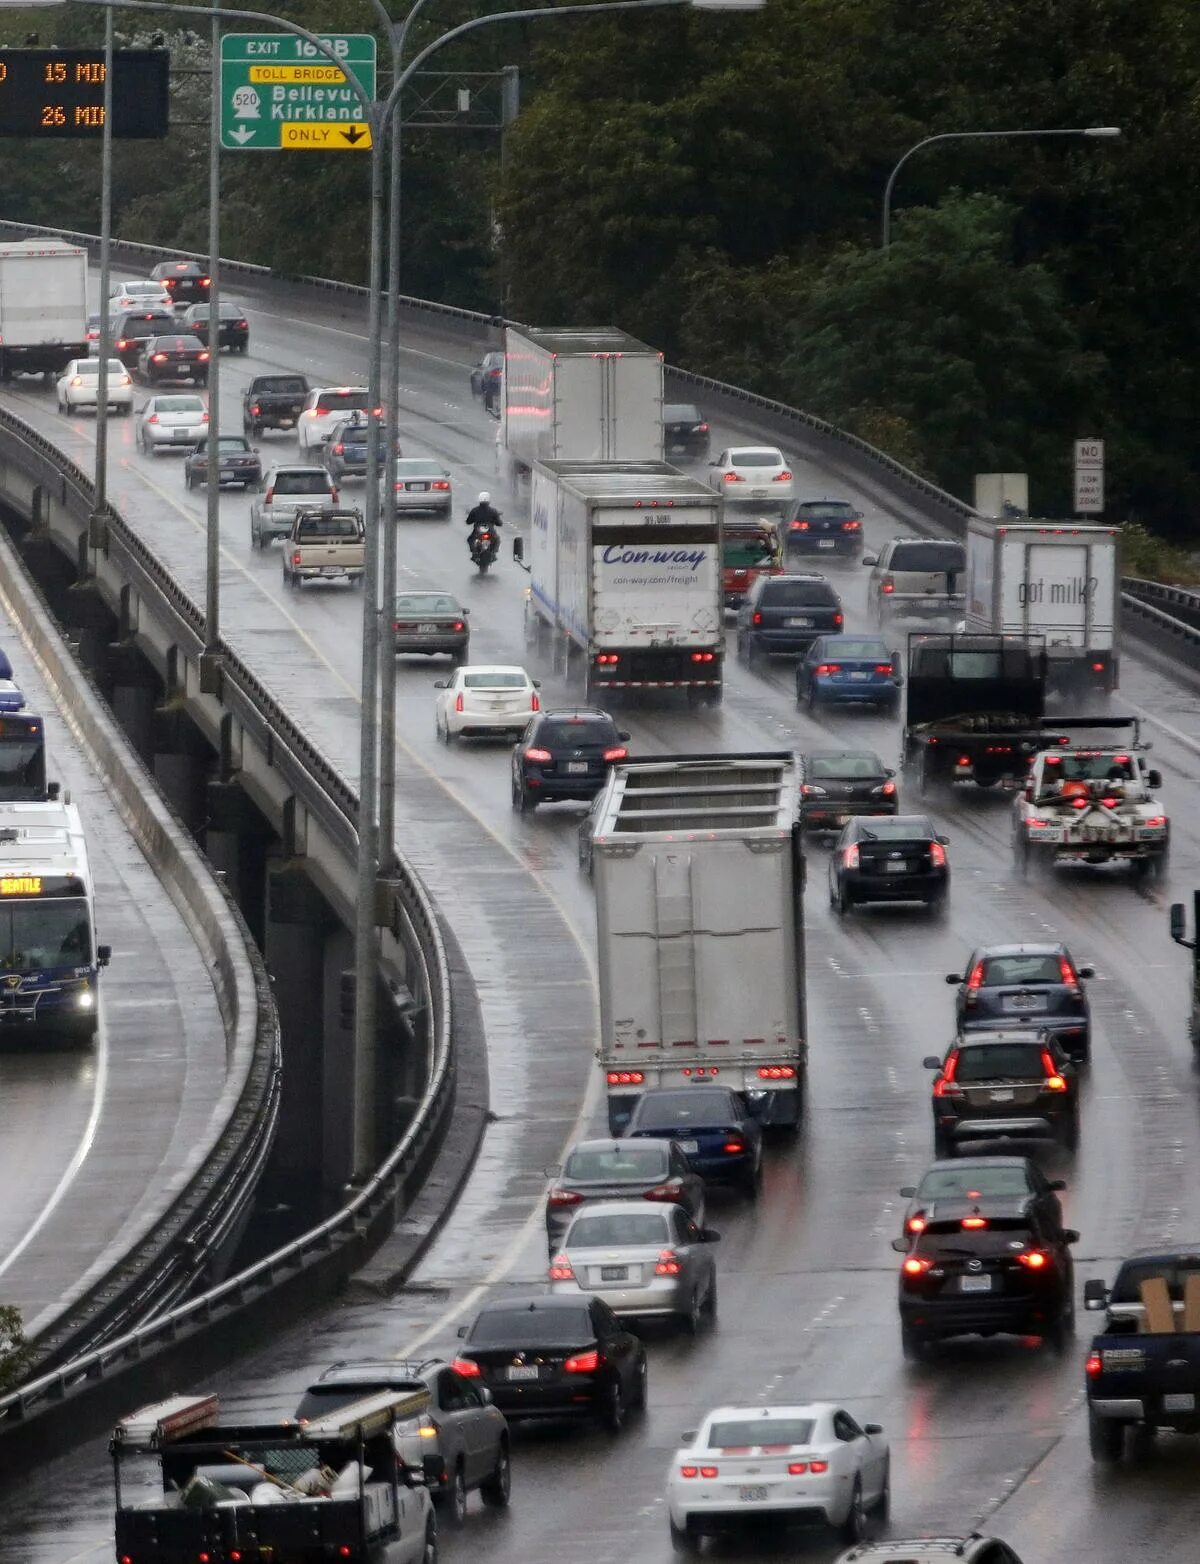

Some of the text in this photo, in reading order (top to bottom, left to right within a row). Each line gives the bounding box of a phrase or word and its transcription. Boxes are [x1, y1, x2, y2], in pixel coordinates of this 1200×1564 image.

[247, 42, 280, 54] EXIT
[45, 63, 67, 81] 15
[255, 69, 341, 80] TOLL BRIDGE
[236, 93, 257, 106] 520
[272, 85, 361, 102] Bellevu
[41, 106, 66, 125] 26
[271, 103, 363, 120] Kirkland
[288, 129, 330, 141] ONLY
[1081, 446, 1098, 457] NO
[603, 545, 707, 571] Con-way
[1018, 577, 1045, 609] got
[0, 877, 41, 894] SEATTLE
